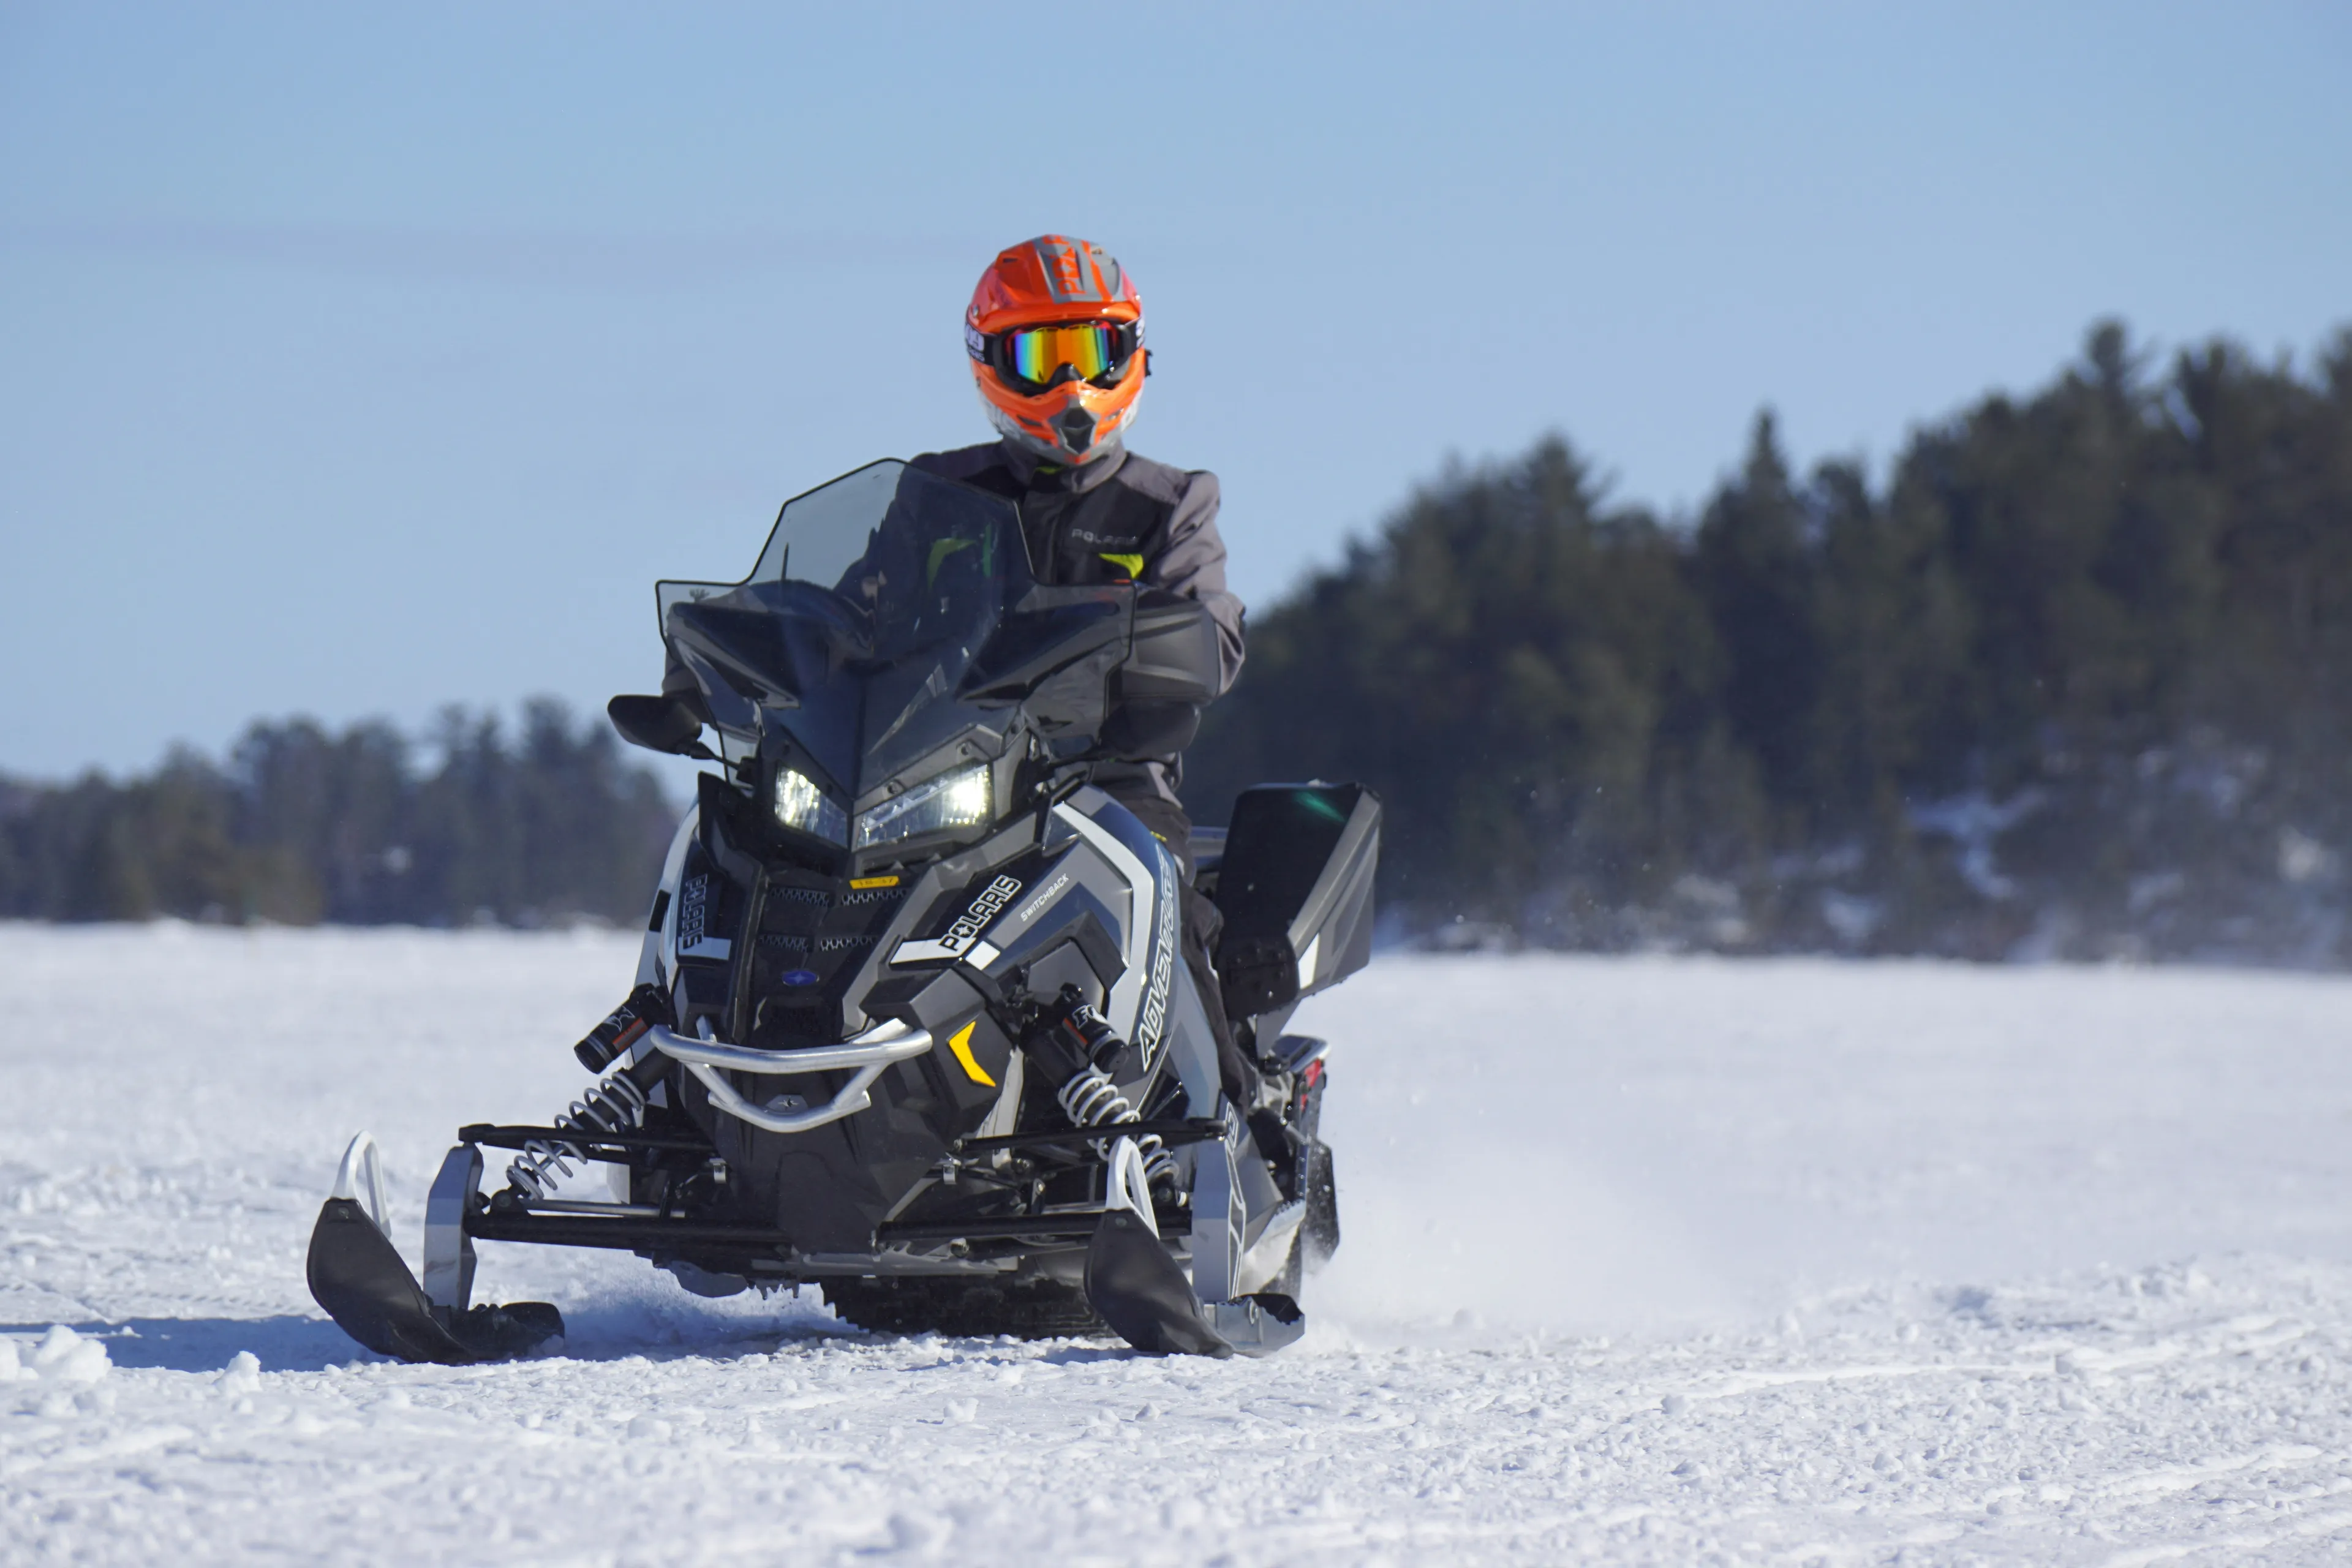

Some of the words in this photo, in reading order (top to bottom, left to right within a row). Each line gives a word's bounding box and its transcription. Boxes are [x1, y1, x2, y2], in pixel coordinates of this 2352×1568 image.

[682, 873, 707, 950] POLARIS
[938, 875, 1022, 951] POLARIS
[1020, 873, 1069, 921] SWITCHBACK
[1137, 843, 1174, 1072] ADVENTURE
